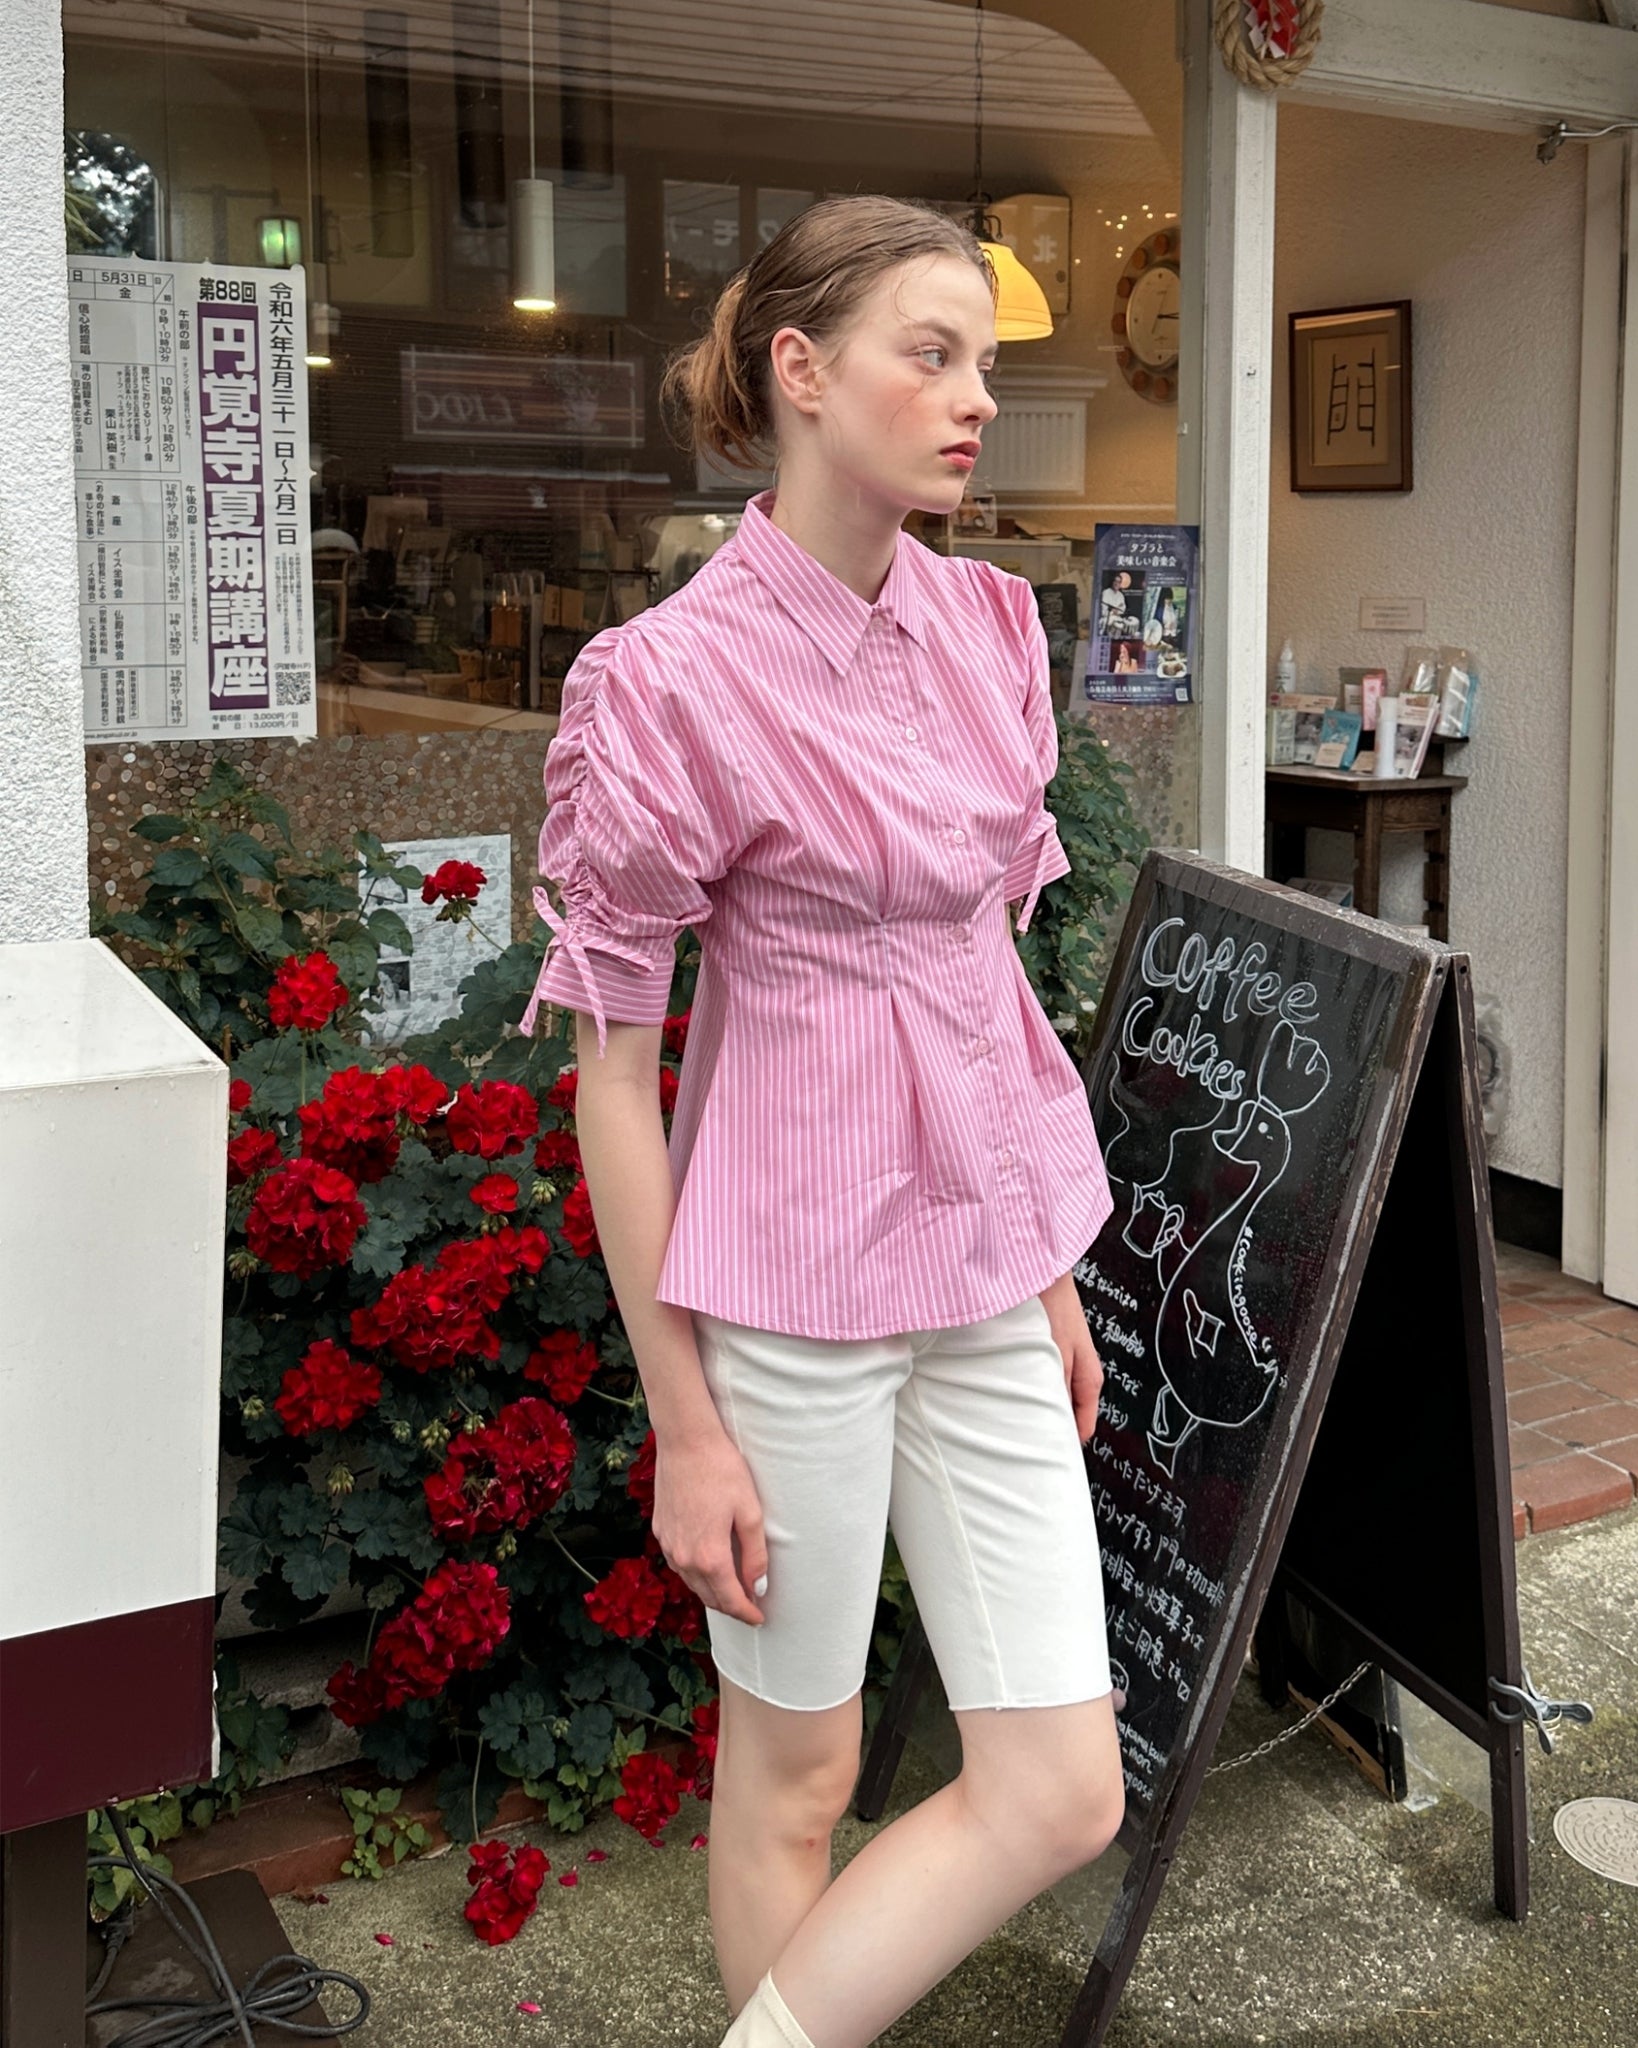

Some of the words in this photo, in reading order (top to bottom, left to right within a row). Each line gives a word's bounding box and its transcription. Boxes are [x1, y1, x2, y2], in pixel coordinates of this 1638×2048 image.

[101, 271, 147, 286] 5月31日
[119, 286, 132, 299] 金
[198, 277, 257, 304] 第88回
[178, 309, 191, 351] 午前の部
[185, 485, 198, 526] 午後の部
[202, 315, 269, 698] 円覚寺夏期講座
[1116, 555, 1177, 568] 美味しい音楽会
[1130, 543, 1165, 554] タブラと
[1141, 917, 1320, 1024] Coffee
[1122, 996, 1246, 1100] Cookies
